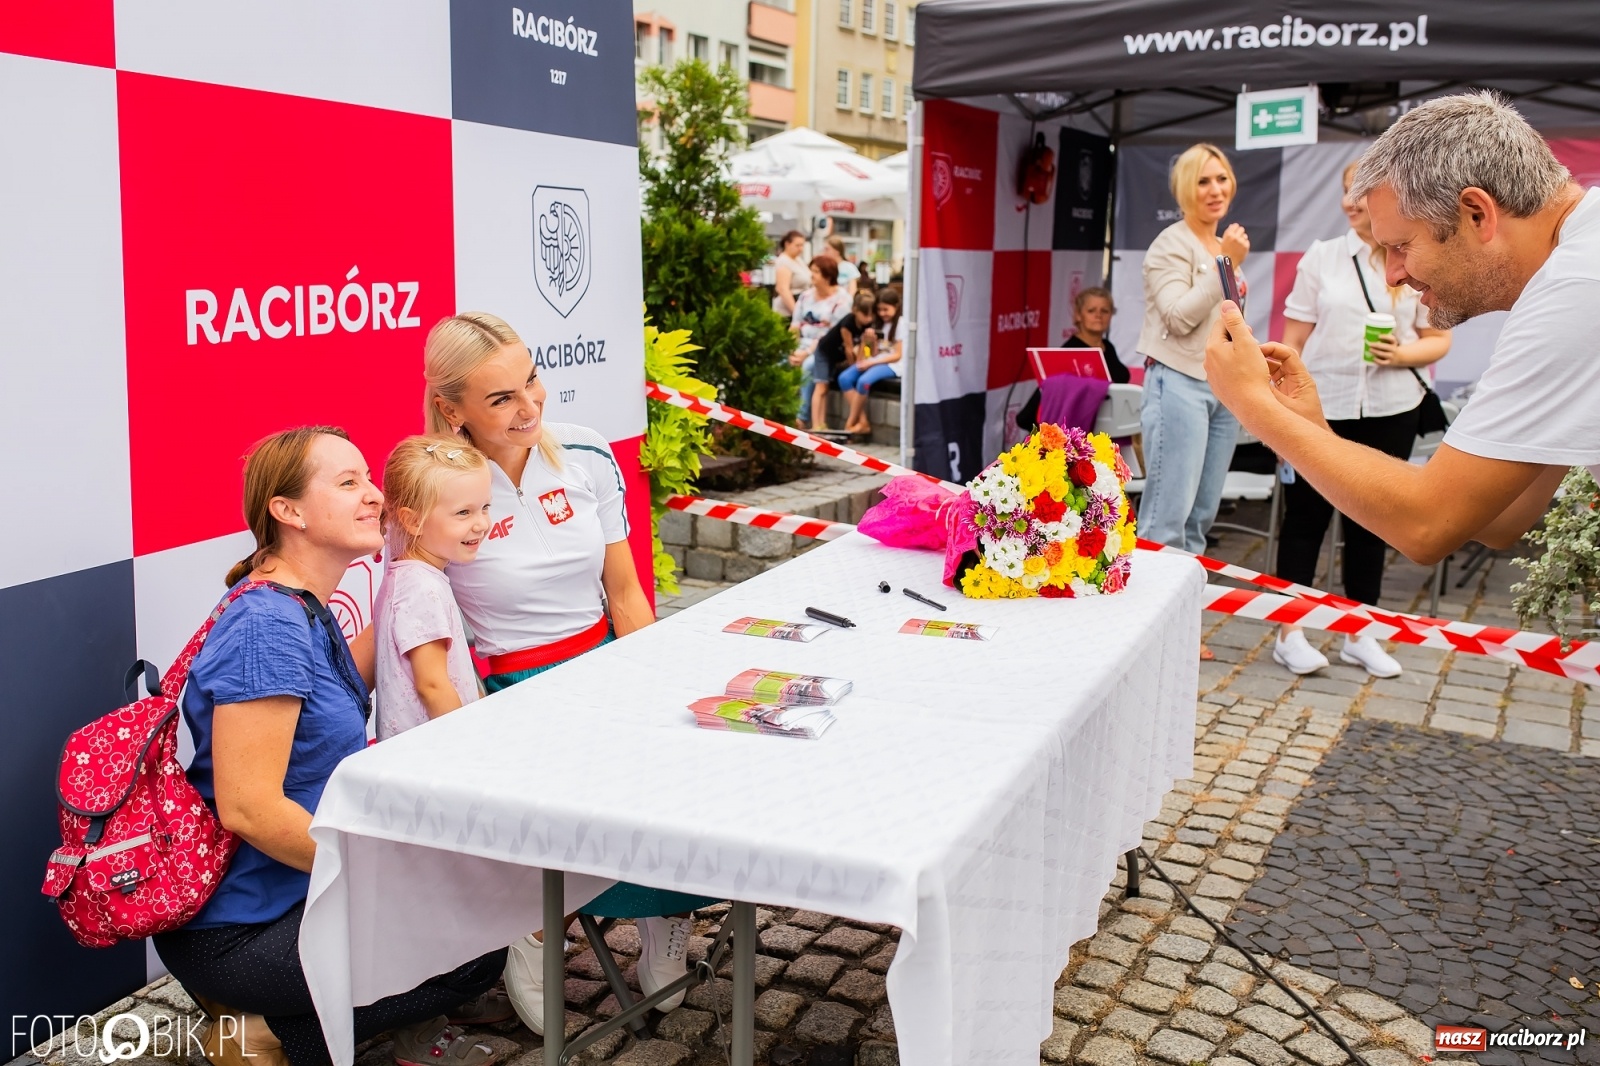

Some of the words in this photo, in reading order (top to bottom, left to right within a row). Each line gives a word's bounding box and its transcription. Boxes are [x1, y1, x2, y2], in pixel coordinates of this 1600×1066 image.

[512, 7, 599, 57] RACIBÓRZ
[1123, 15, 1428, 54] www.raciborz.pl
[549, 69, 567, 85] 1217
[185, 264, 421, 346] RACIBÓRZ
[559, 389, 575, 403] 1217
